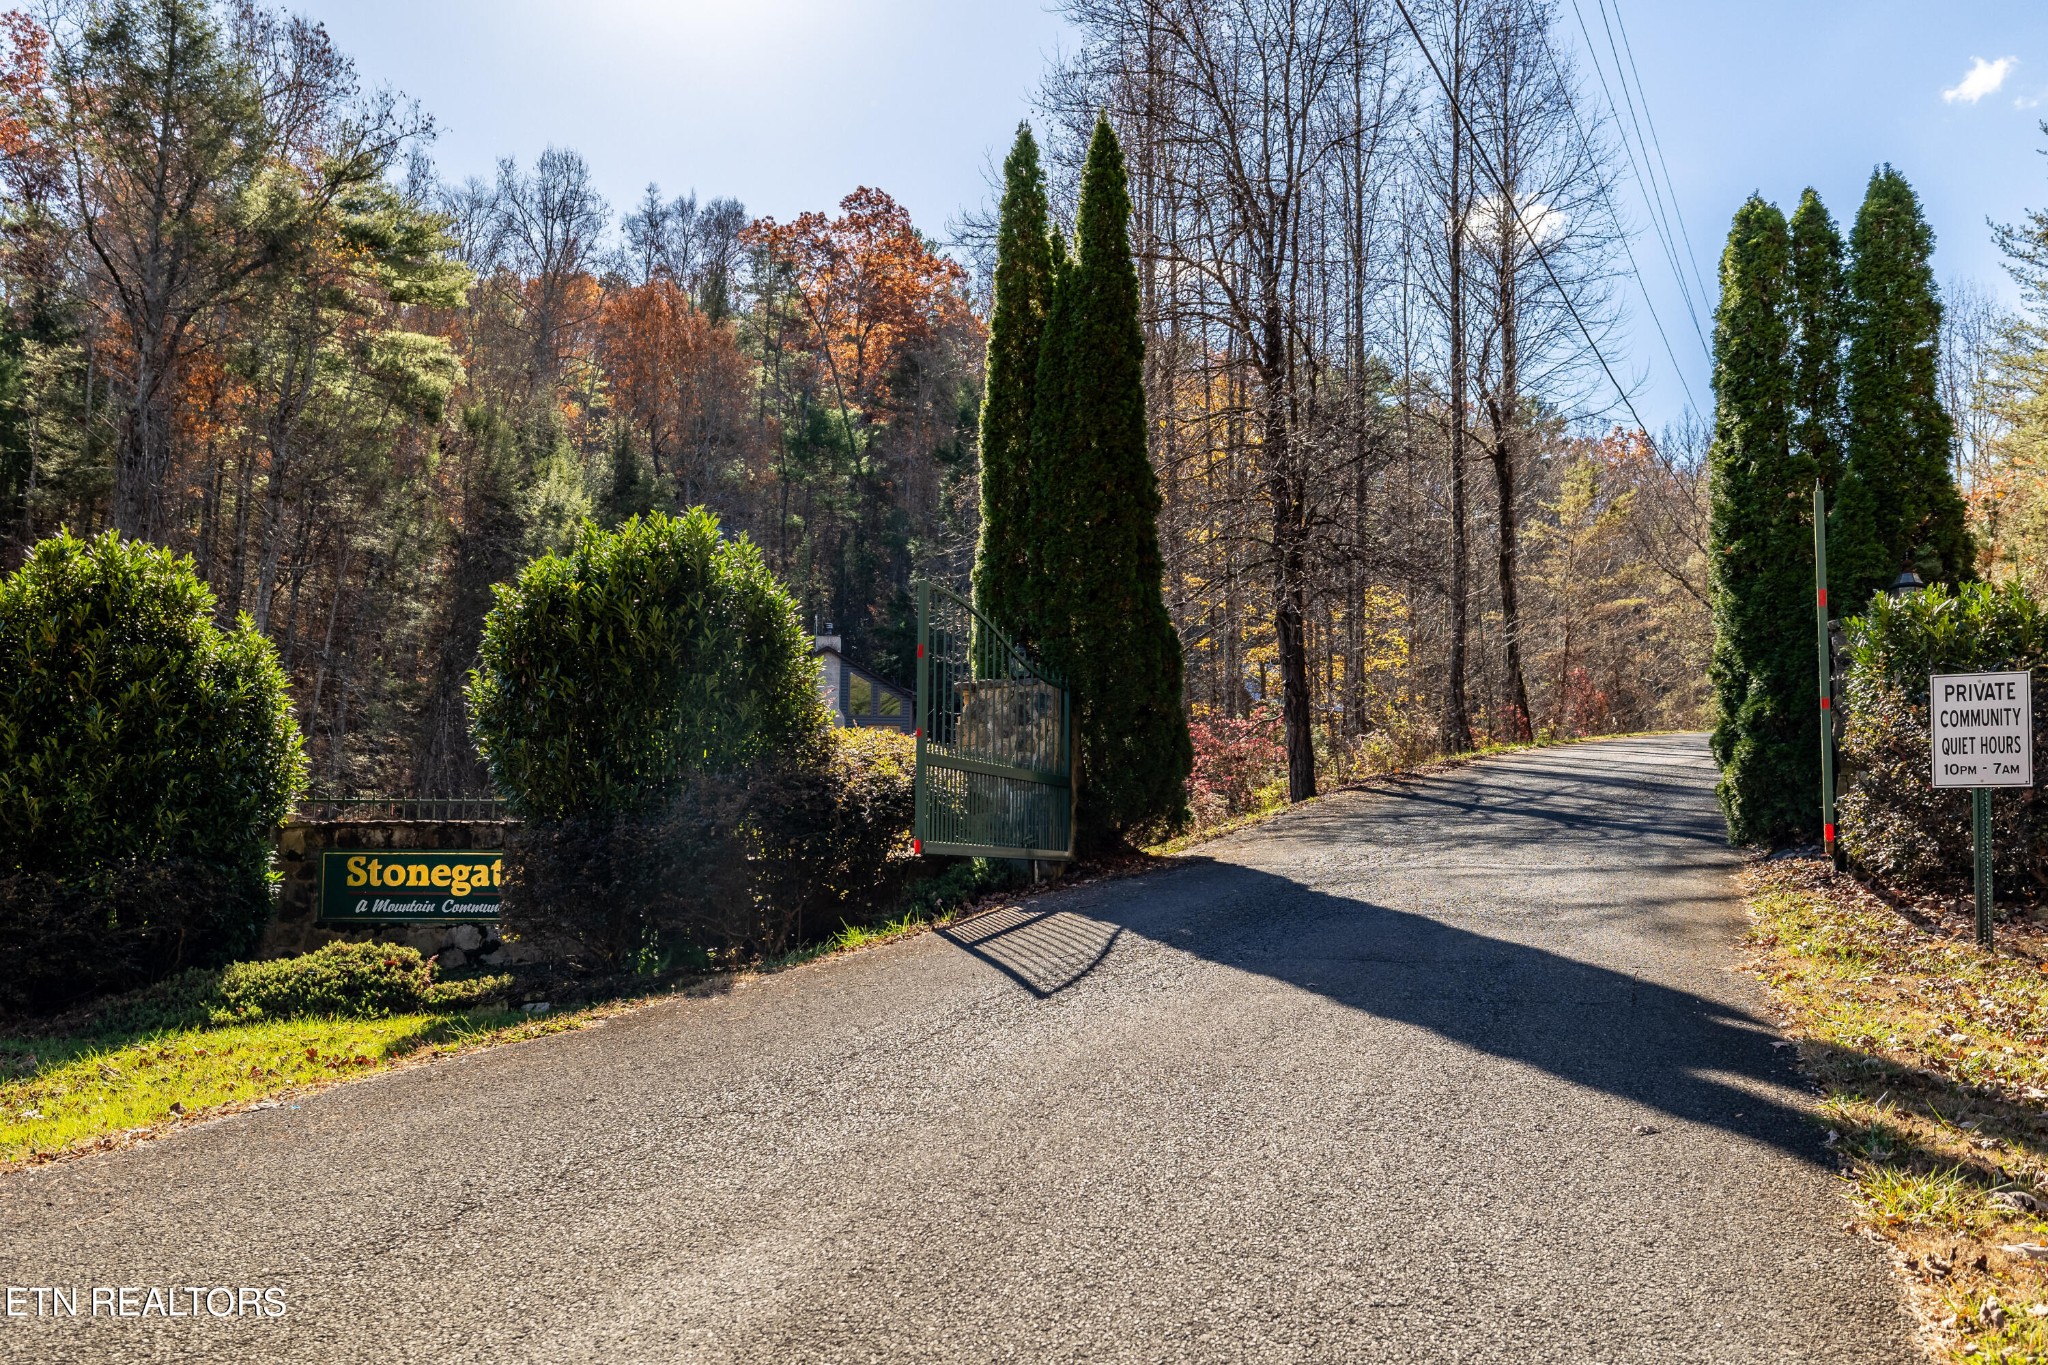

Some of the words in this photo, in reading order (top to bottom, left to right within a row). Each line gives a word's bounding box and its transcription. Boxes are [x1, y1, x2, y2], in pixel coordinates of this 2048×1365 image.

[1944, 682, 2016, 702] PRIVATE
[1940, 707, 2021, 728] COMMUNITY
[1941, 736, 1976, 756] QUIET
[1980, 735, 2021, 755] HOURS
[1944, 763, 1977, 775] 10PM
[1993, 762, 2020, 775] 7AM
[372, 899, 436, 913] Mountain
